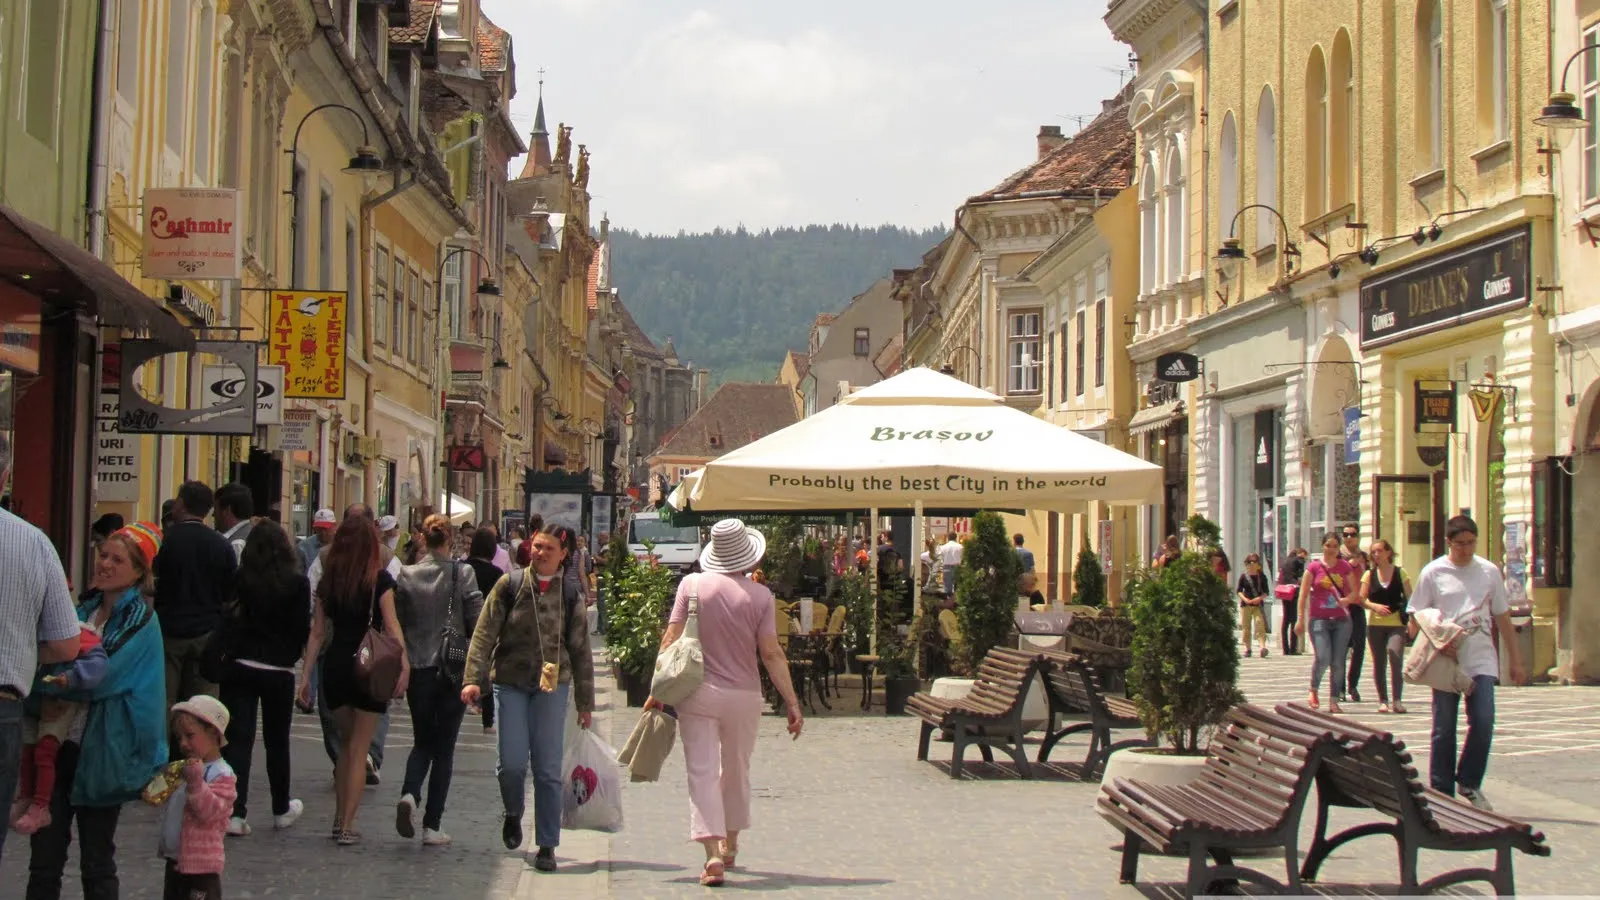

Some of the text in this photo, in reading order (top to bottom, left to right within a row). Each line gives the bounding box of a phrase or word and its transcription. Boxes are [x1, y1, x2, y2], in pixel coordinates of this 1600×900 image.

[151, 206, 232, 239] Cashmir
[454, 449, 478, 468] K
[769, 474, 1106, 494] Probably the best City in the world
